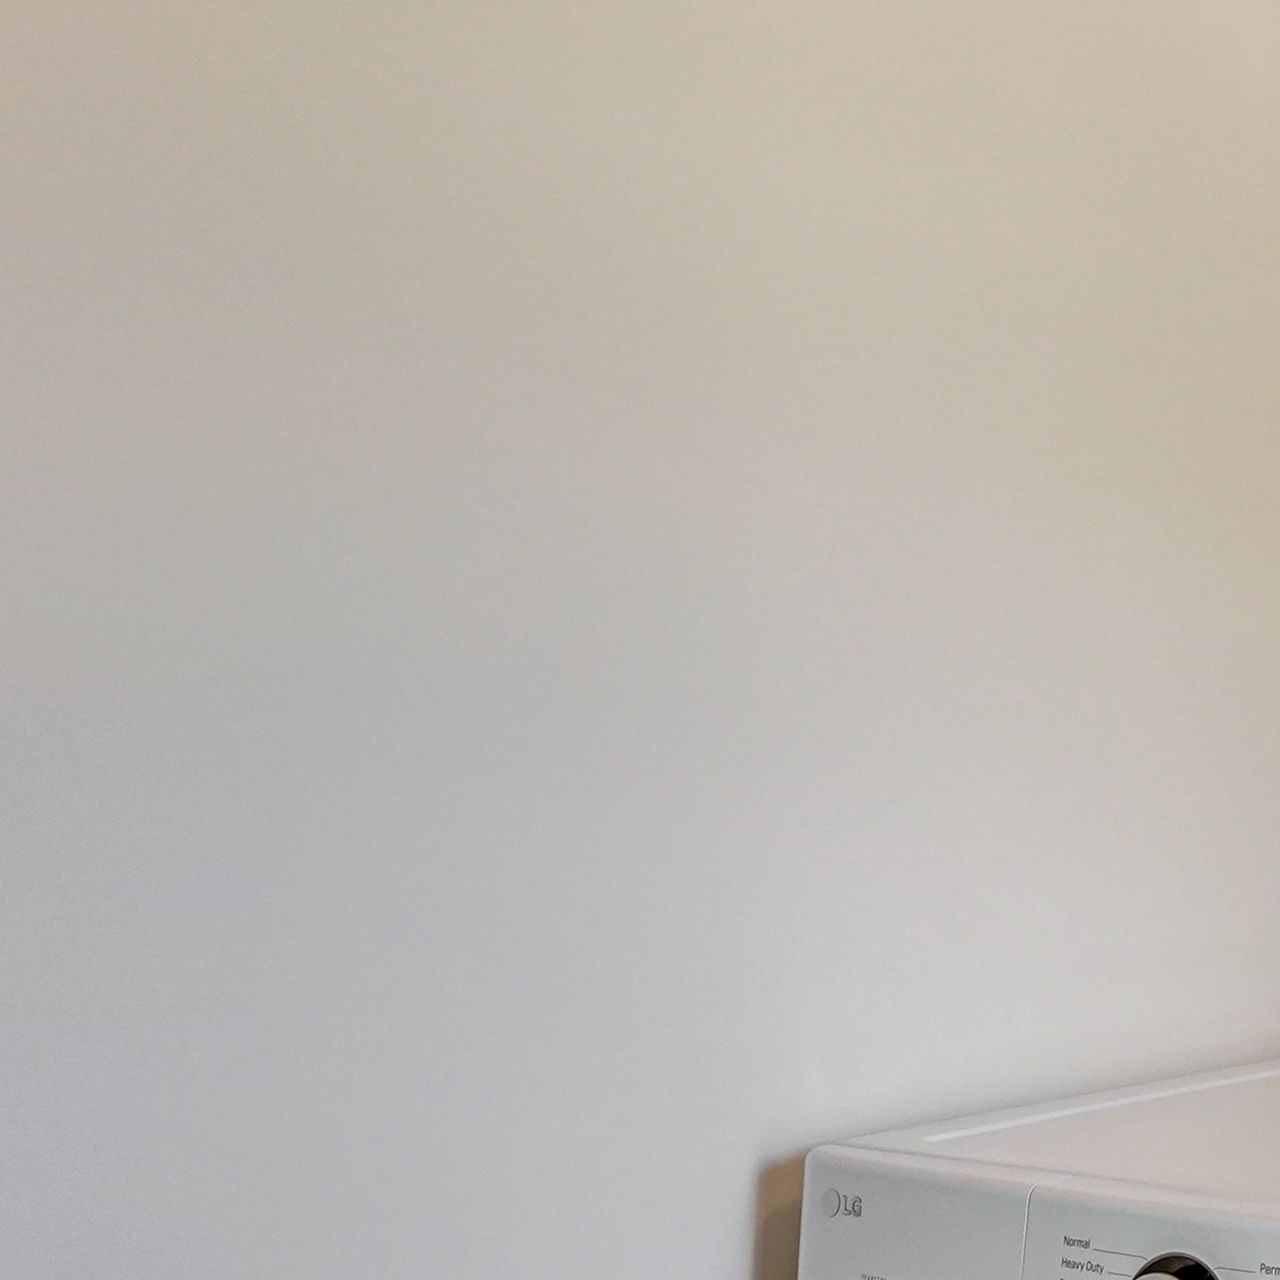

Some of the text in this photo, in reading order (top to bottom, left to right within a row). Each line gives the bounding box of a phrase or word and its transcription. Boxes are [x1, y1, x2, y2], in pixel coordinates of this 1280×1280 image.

[842, 1194, 863, 1217] LG
[1063, 1235, 1091, 1249] Normal
[1061, 1257, 1104, 1275] Heavy Duty
